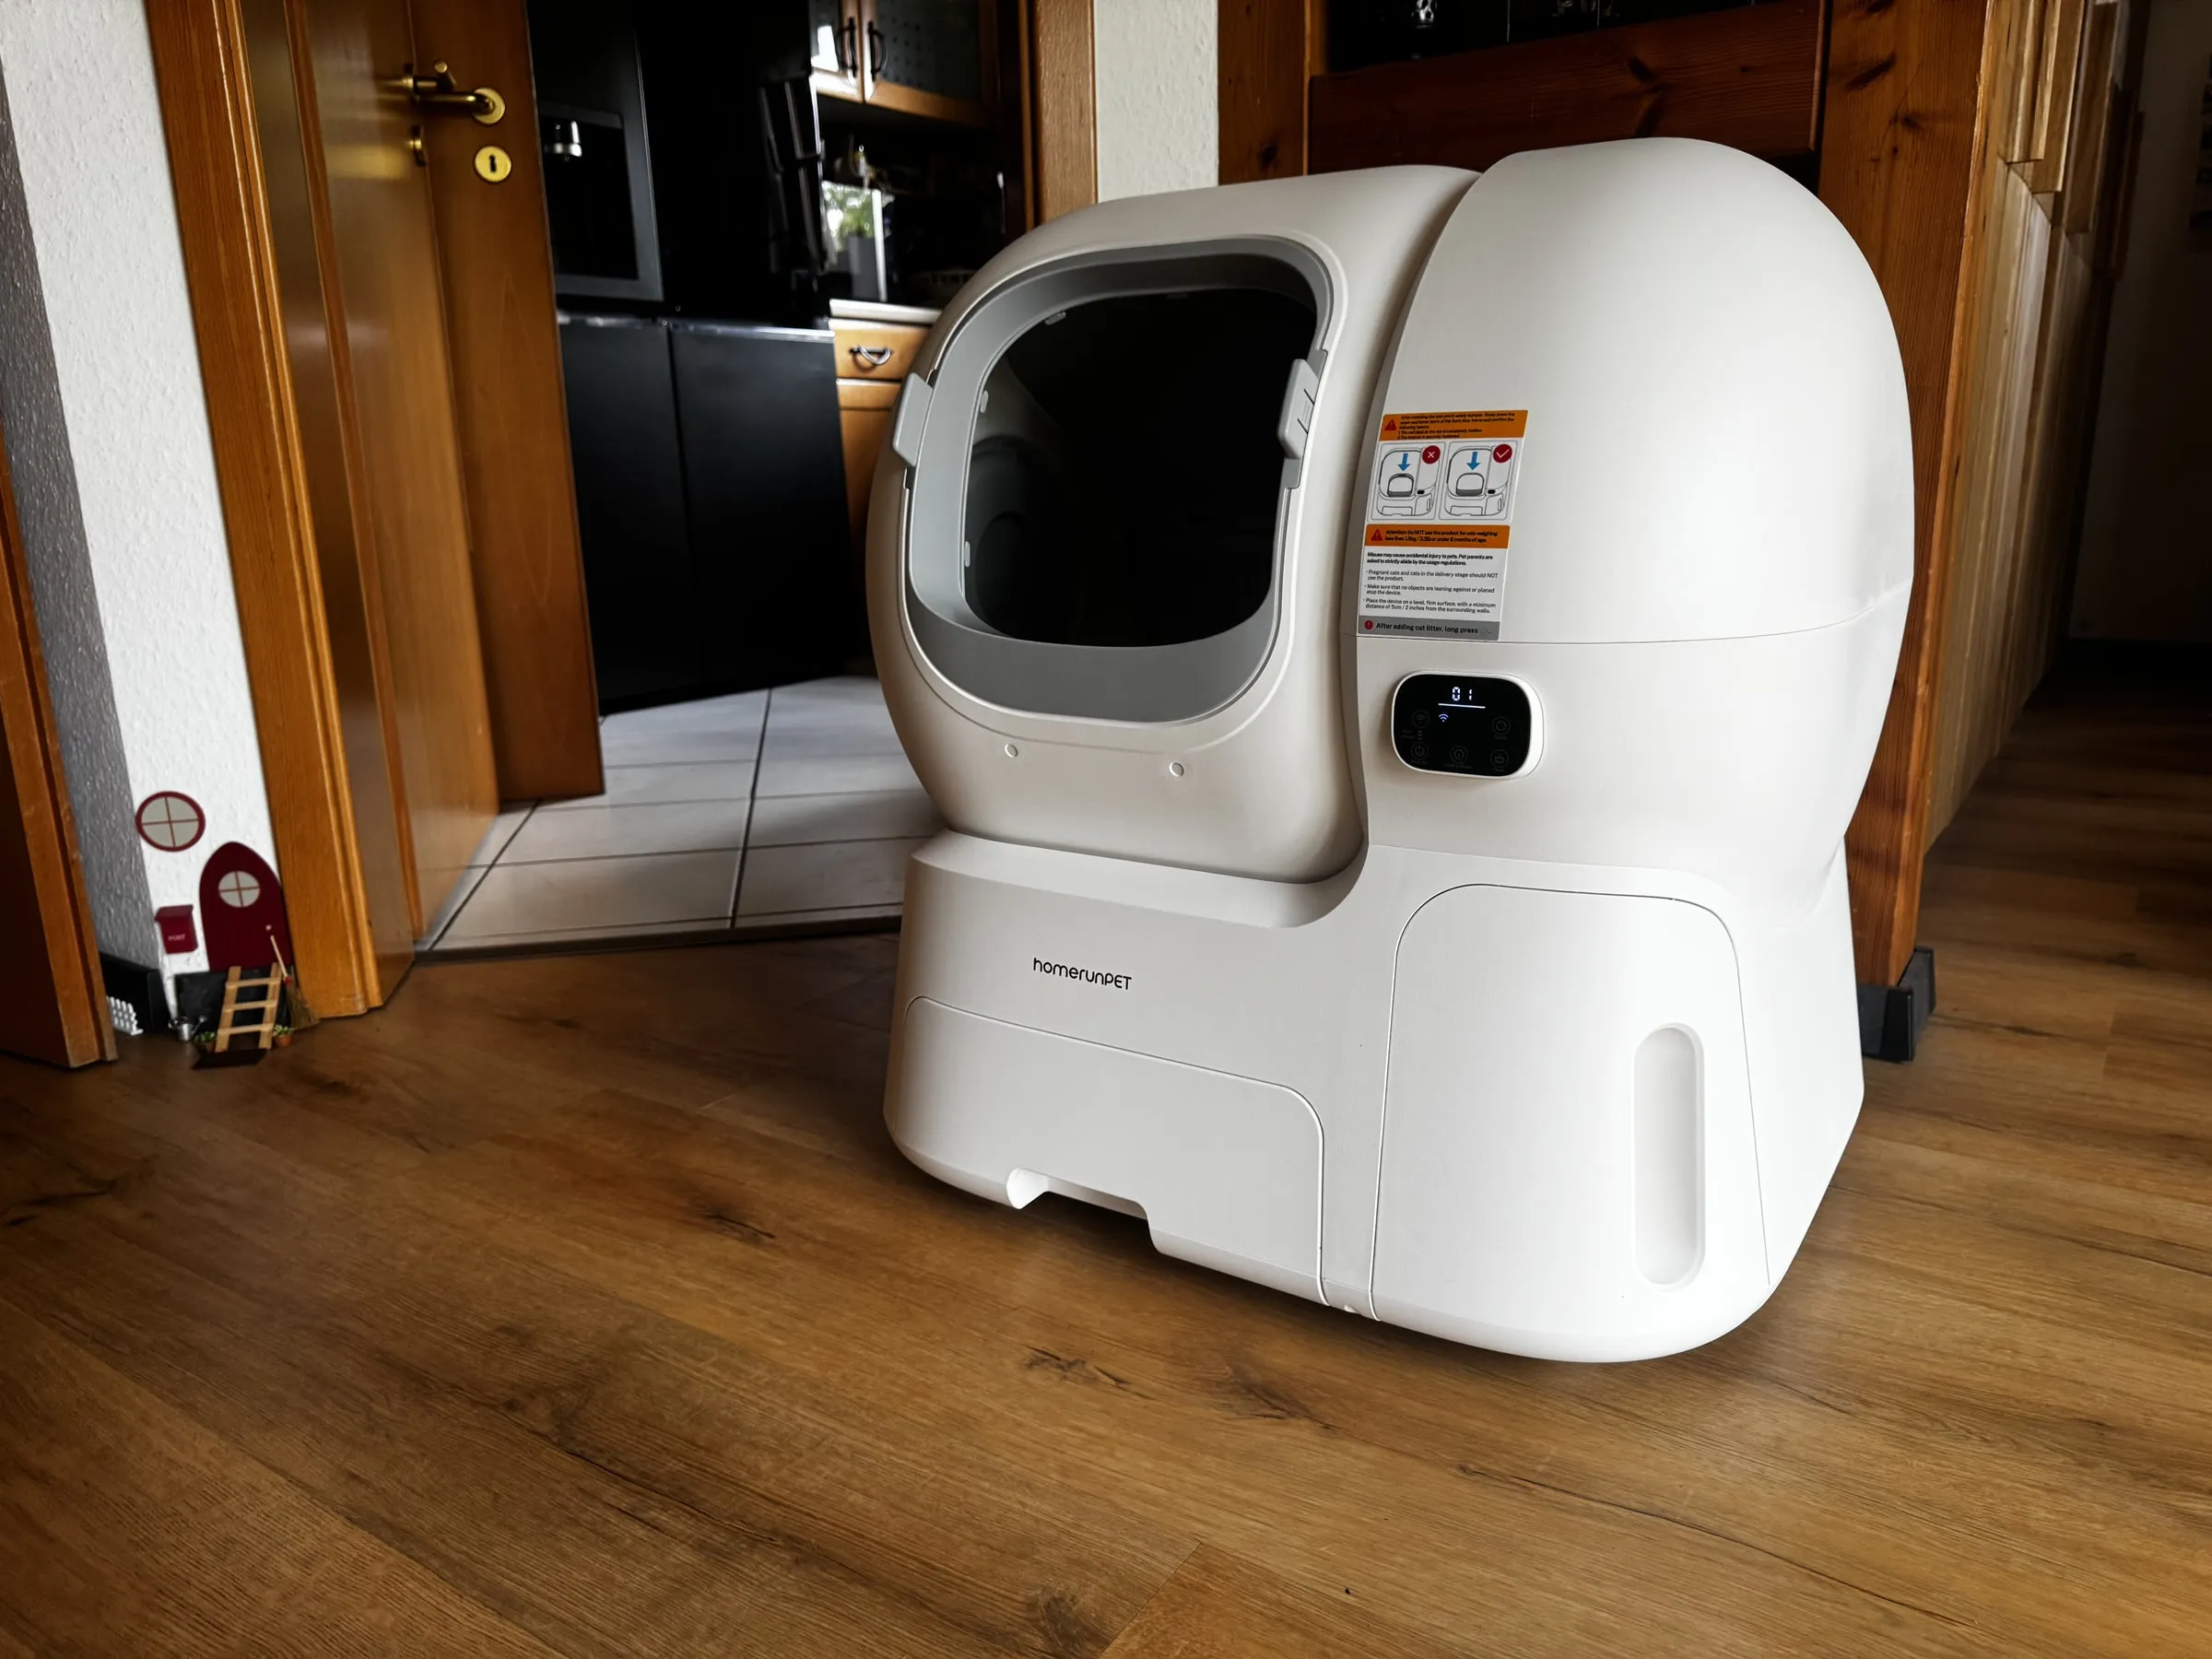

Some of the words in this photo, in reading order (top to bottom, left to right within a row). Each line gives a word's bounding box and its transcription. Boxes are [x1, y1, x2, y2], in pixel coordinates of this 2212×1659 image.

[1393, 623, 1415, 631] adding
[1452, 686, 1472, 701] 01
[1033, 957, 1132, 990] homerunPET
